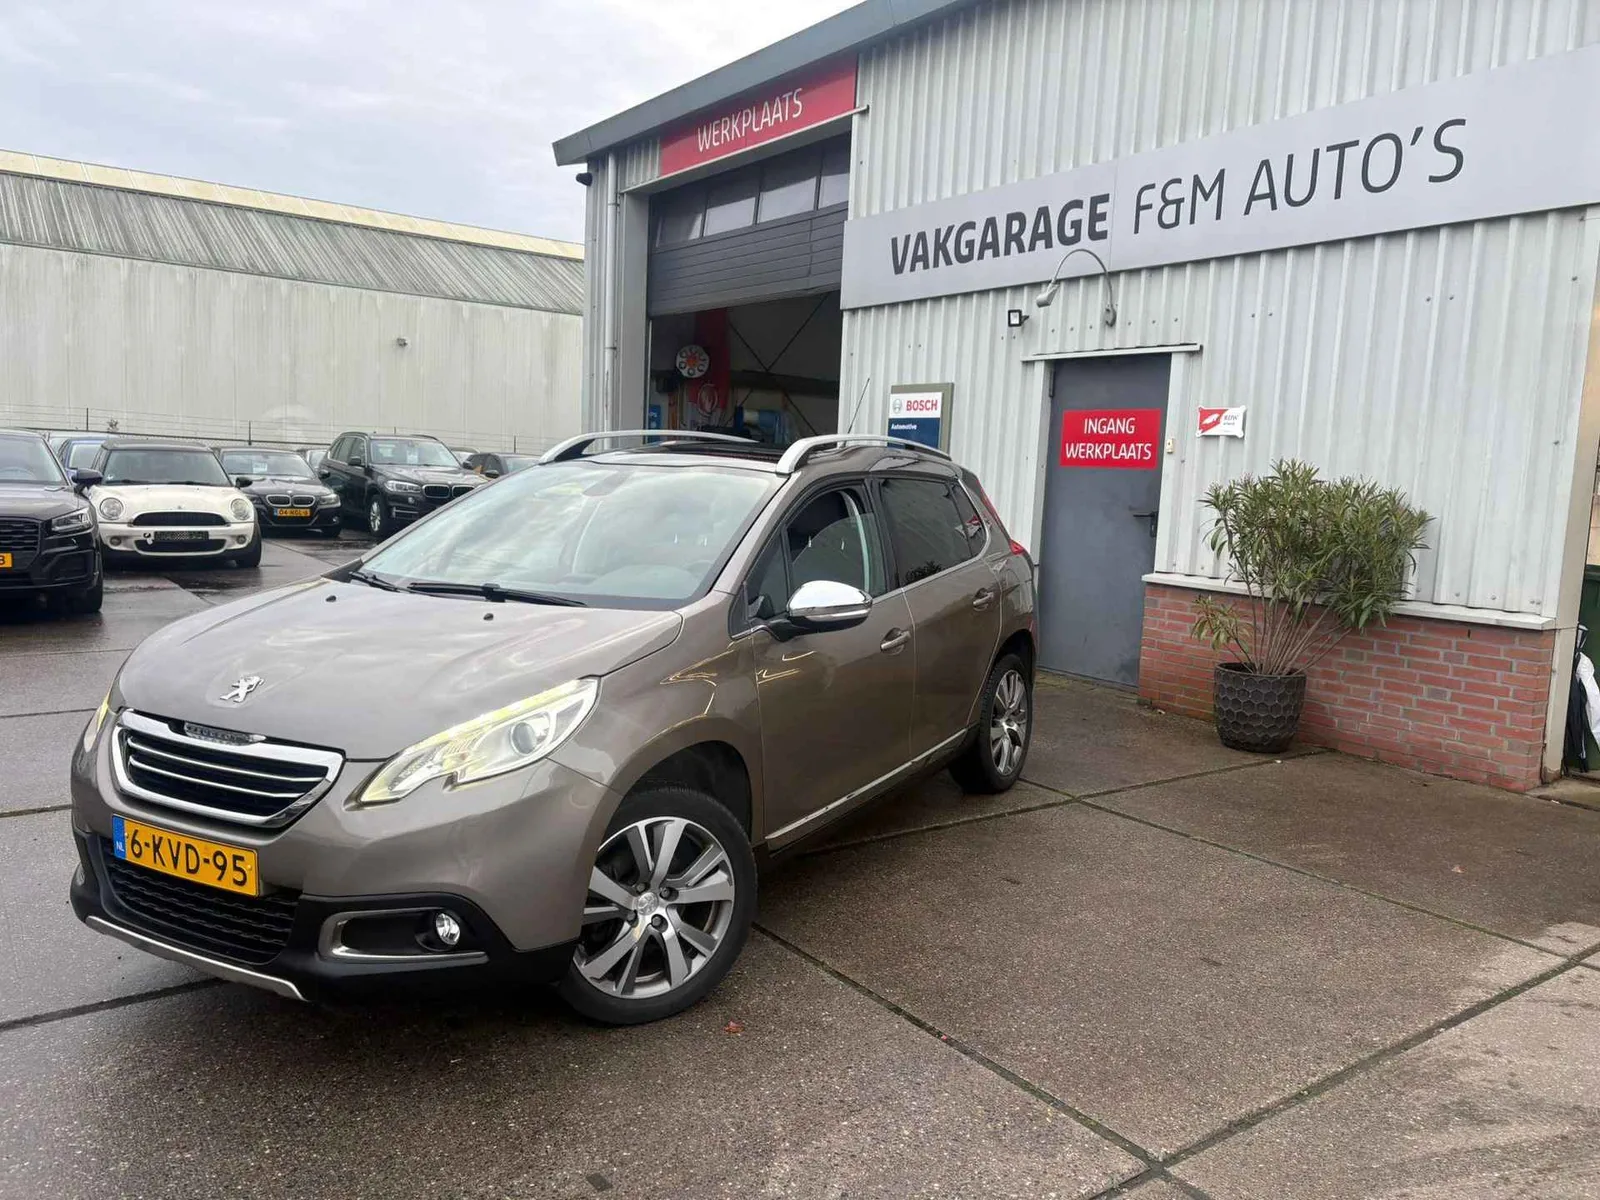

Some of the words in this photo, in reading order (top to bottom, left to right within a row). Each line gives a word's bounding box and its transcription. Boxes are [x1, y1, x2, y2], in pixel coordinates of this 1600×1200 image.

[697, 87, 803, 153] WERKPLAATS
[890, 193, 1111, 275] VAKGARAGE
[1133, 168, 1226, 235] F&M
[1243, 118, 1467, 216] AUTO'S
[906, 399, 938, 411] BOSCH
[1083, 417, 1136, 434] INGANG
[1065, 443, 1152, 460] WERKPLAATS
[116, 840, 125, 852] NL
[130, 829, 247, 887] 6-KVD-95
